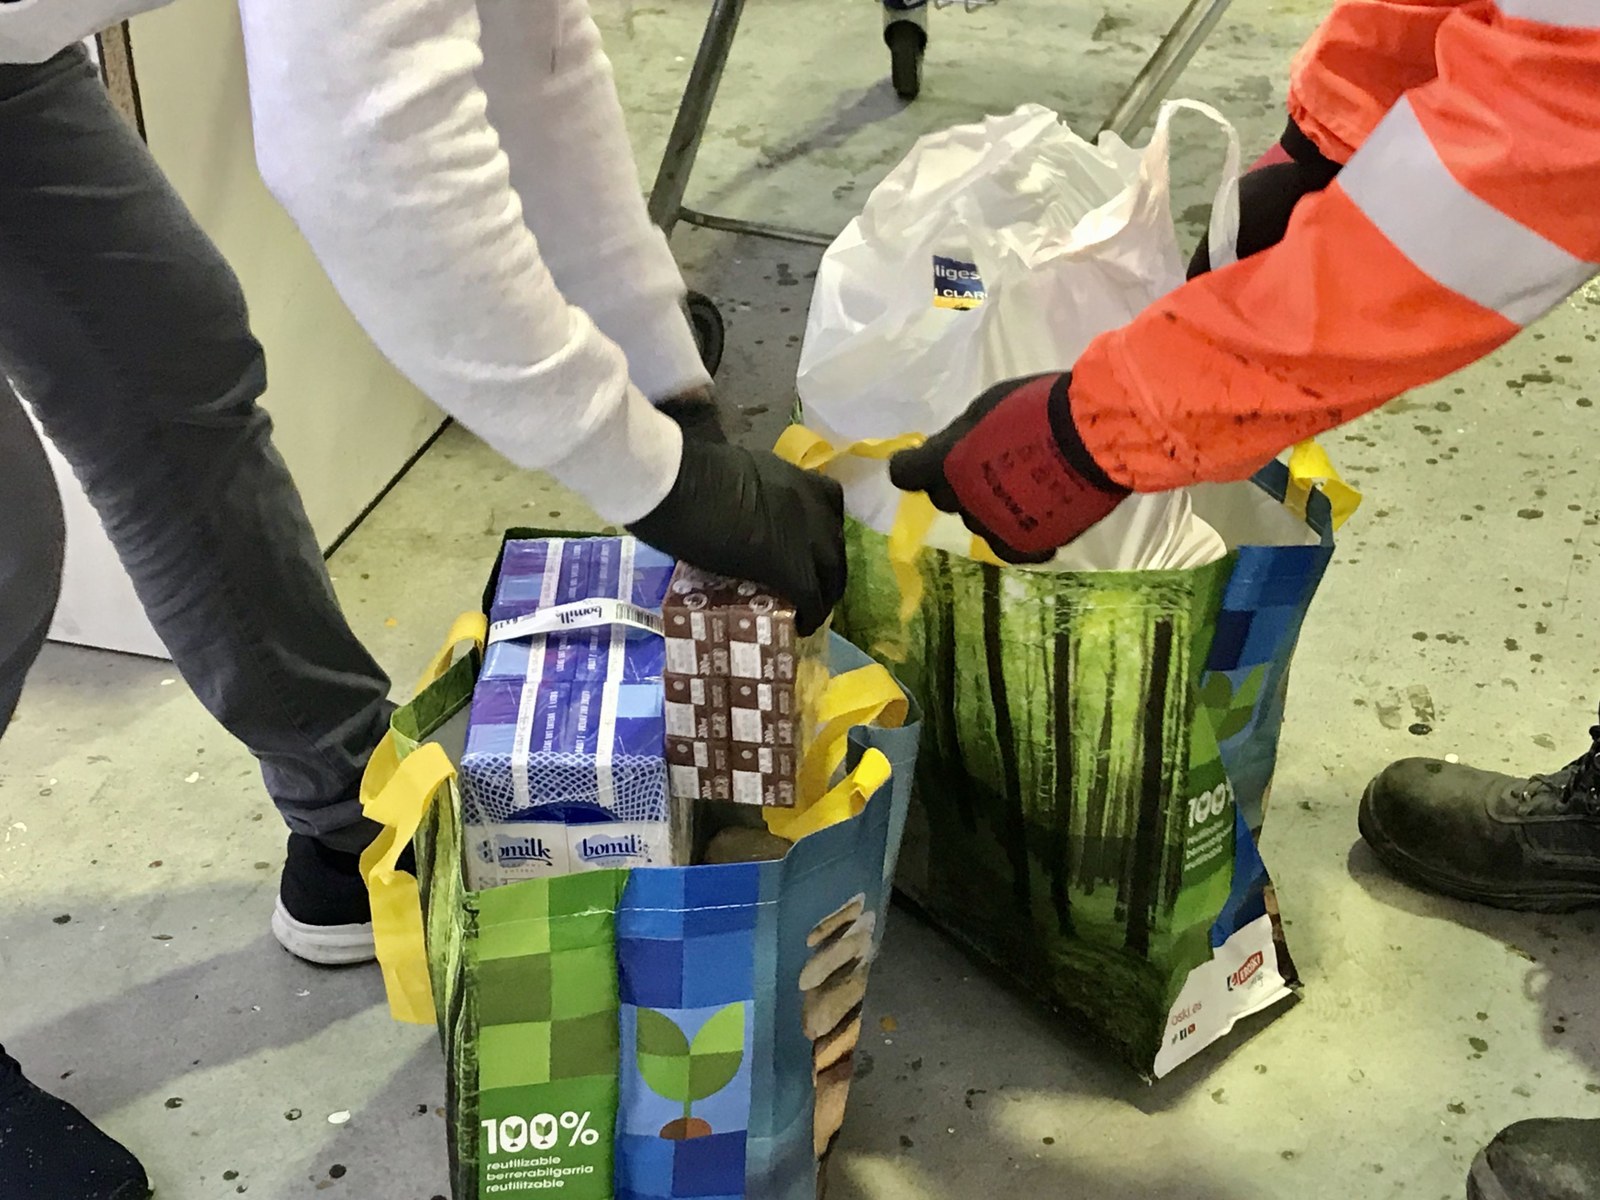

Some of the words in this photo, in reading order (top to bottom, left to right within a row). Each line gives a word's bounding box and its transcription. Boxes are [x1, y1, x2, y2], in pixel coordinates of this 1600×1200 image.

[943, 289, 988, 300] CLAR
[481, 1111, 599, 1154] 100%
[486, 1156, 561, 1171] reutilizable
[486, 1164, 594, 1181] berrerabilgarria
[485, 1179, 565, 1193] reutilitzable
